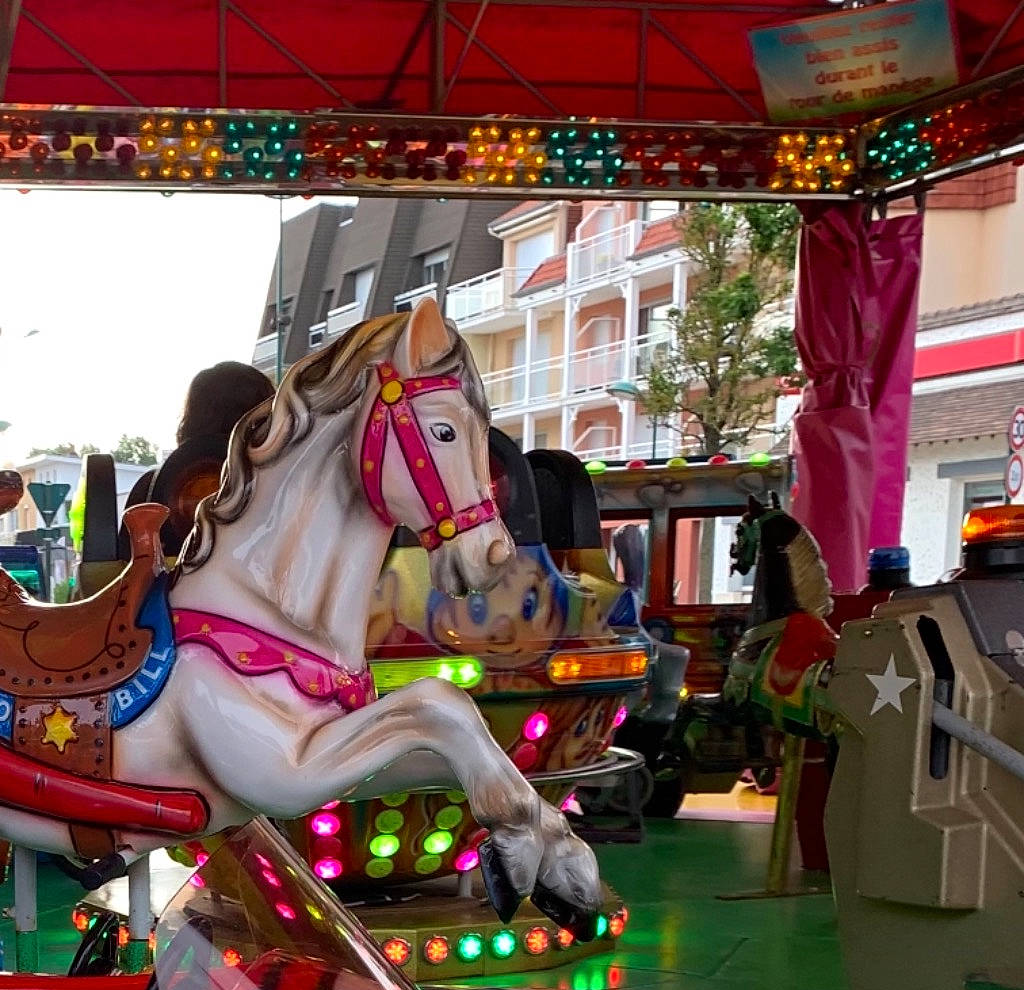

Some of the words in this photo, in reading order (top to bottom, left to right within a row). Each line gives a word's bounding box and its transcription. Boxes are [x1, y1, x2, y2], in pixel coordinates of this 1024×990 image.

[815, 65, 873, 84] durant
[881, 60, 898, 74] le
[115, 645, 173, 712] BILL
